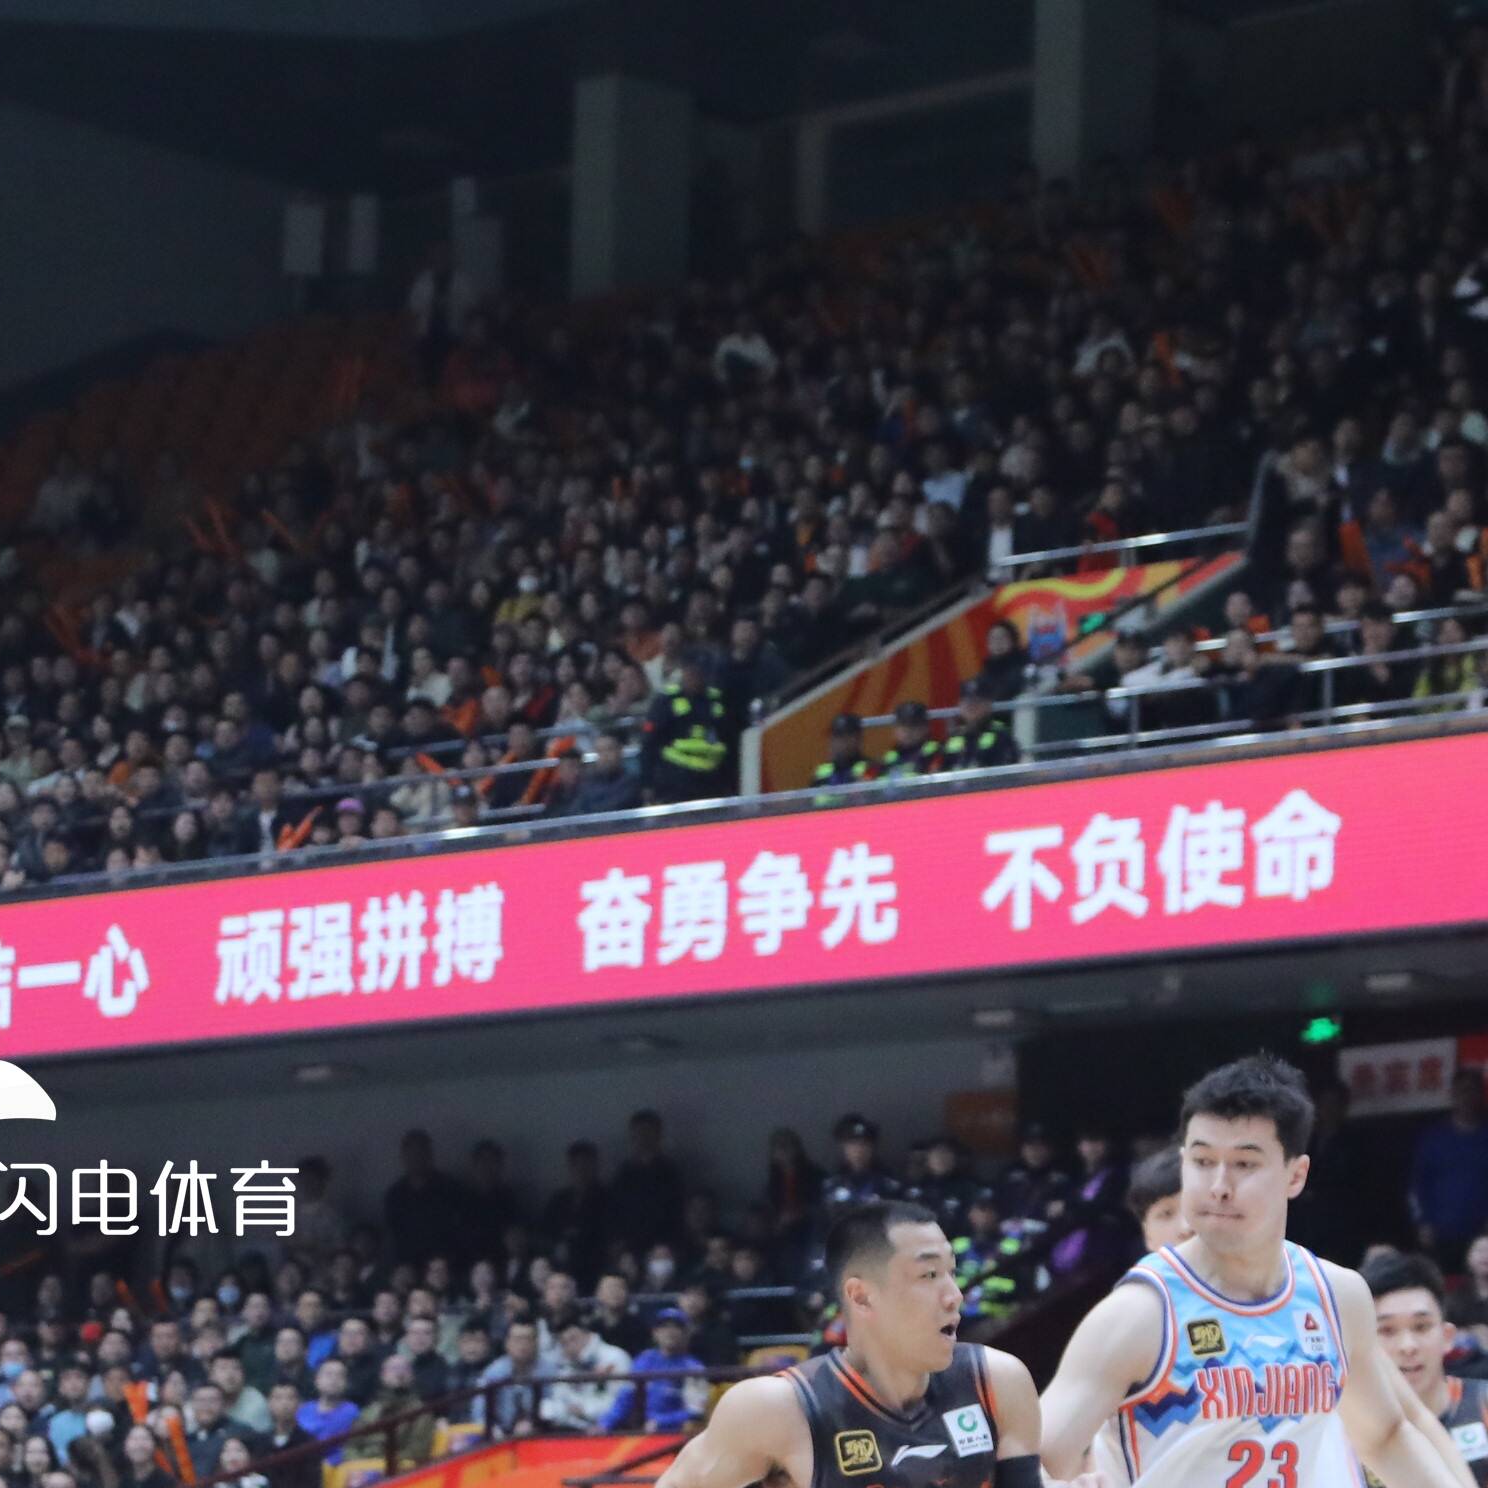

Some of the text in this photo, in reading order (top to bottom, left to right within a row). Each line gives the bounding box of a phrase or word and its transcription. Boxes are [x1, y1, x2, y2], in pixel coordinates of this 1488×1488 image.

[215, 882, 505, 1005] 顽强拼搏
[576, 842, 899, 972] 奋勇争先
[981, 788, 1341, 931] 不负使命
[1196, 1361, 1338, 1421] XINJIANG
